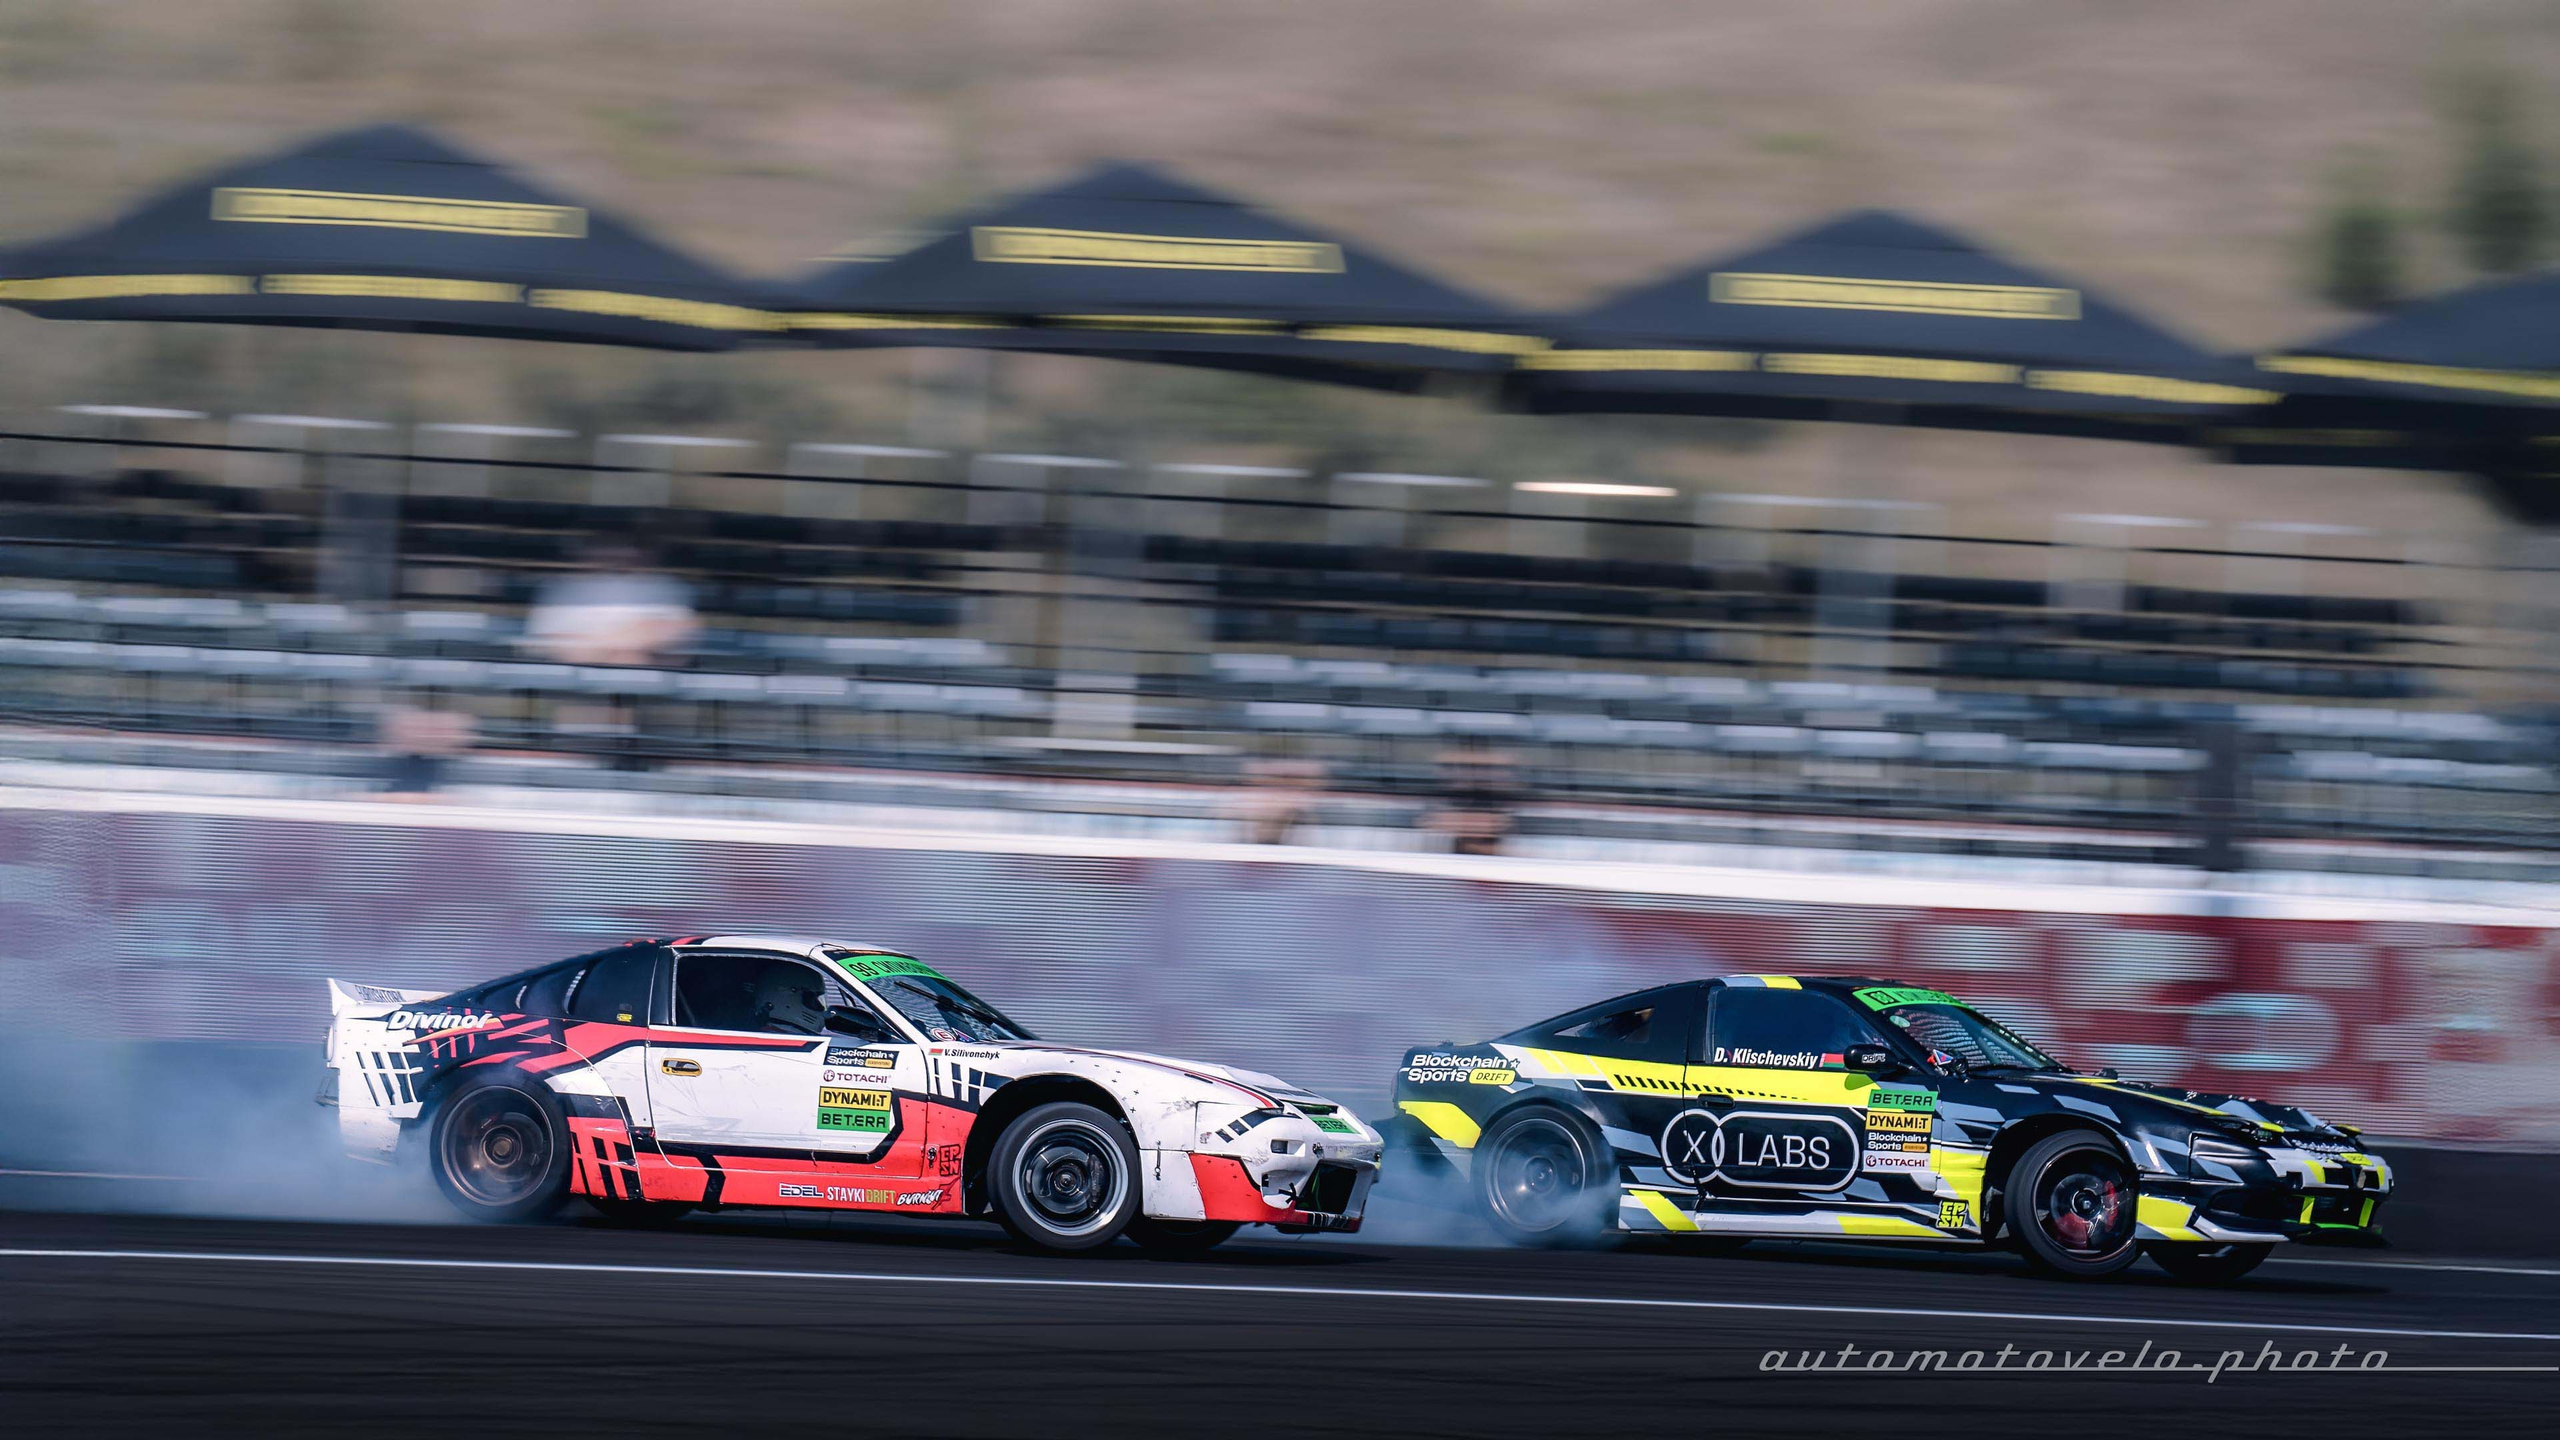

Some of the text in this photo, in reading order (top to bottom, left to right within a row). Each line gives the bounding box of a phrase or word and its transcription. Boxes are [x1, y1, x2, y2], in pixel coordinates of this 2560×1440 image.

[849, 961, 880, 977] 99
[387, 1010, 493, 1031] Divinol
[826, 1055, 865, 1067] Sports
[1411, 1054, 1508, 1069] Blockchain
[1714, 1047, 1818, 1070] D. Klischevskiy
[836, 1072, 888, 1084] TOTACHI
[1407, 1068, 1510, 1084] Sports DRIFT
[1868, 1132, 1922, 1143] Blockchain
[1681, 1129, 1831, 1171] X LABS
[1867, 1141, 1902, 1151] Sports
[1878, 1157, 1926, 1168] TOTACHI
